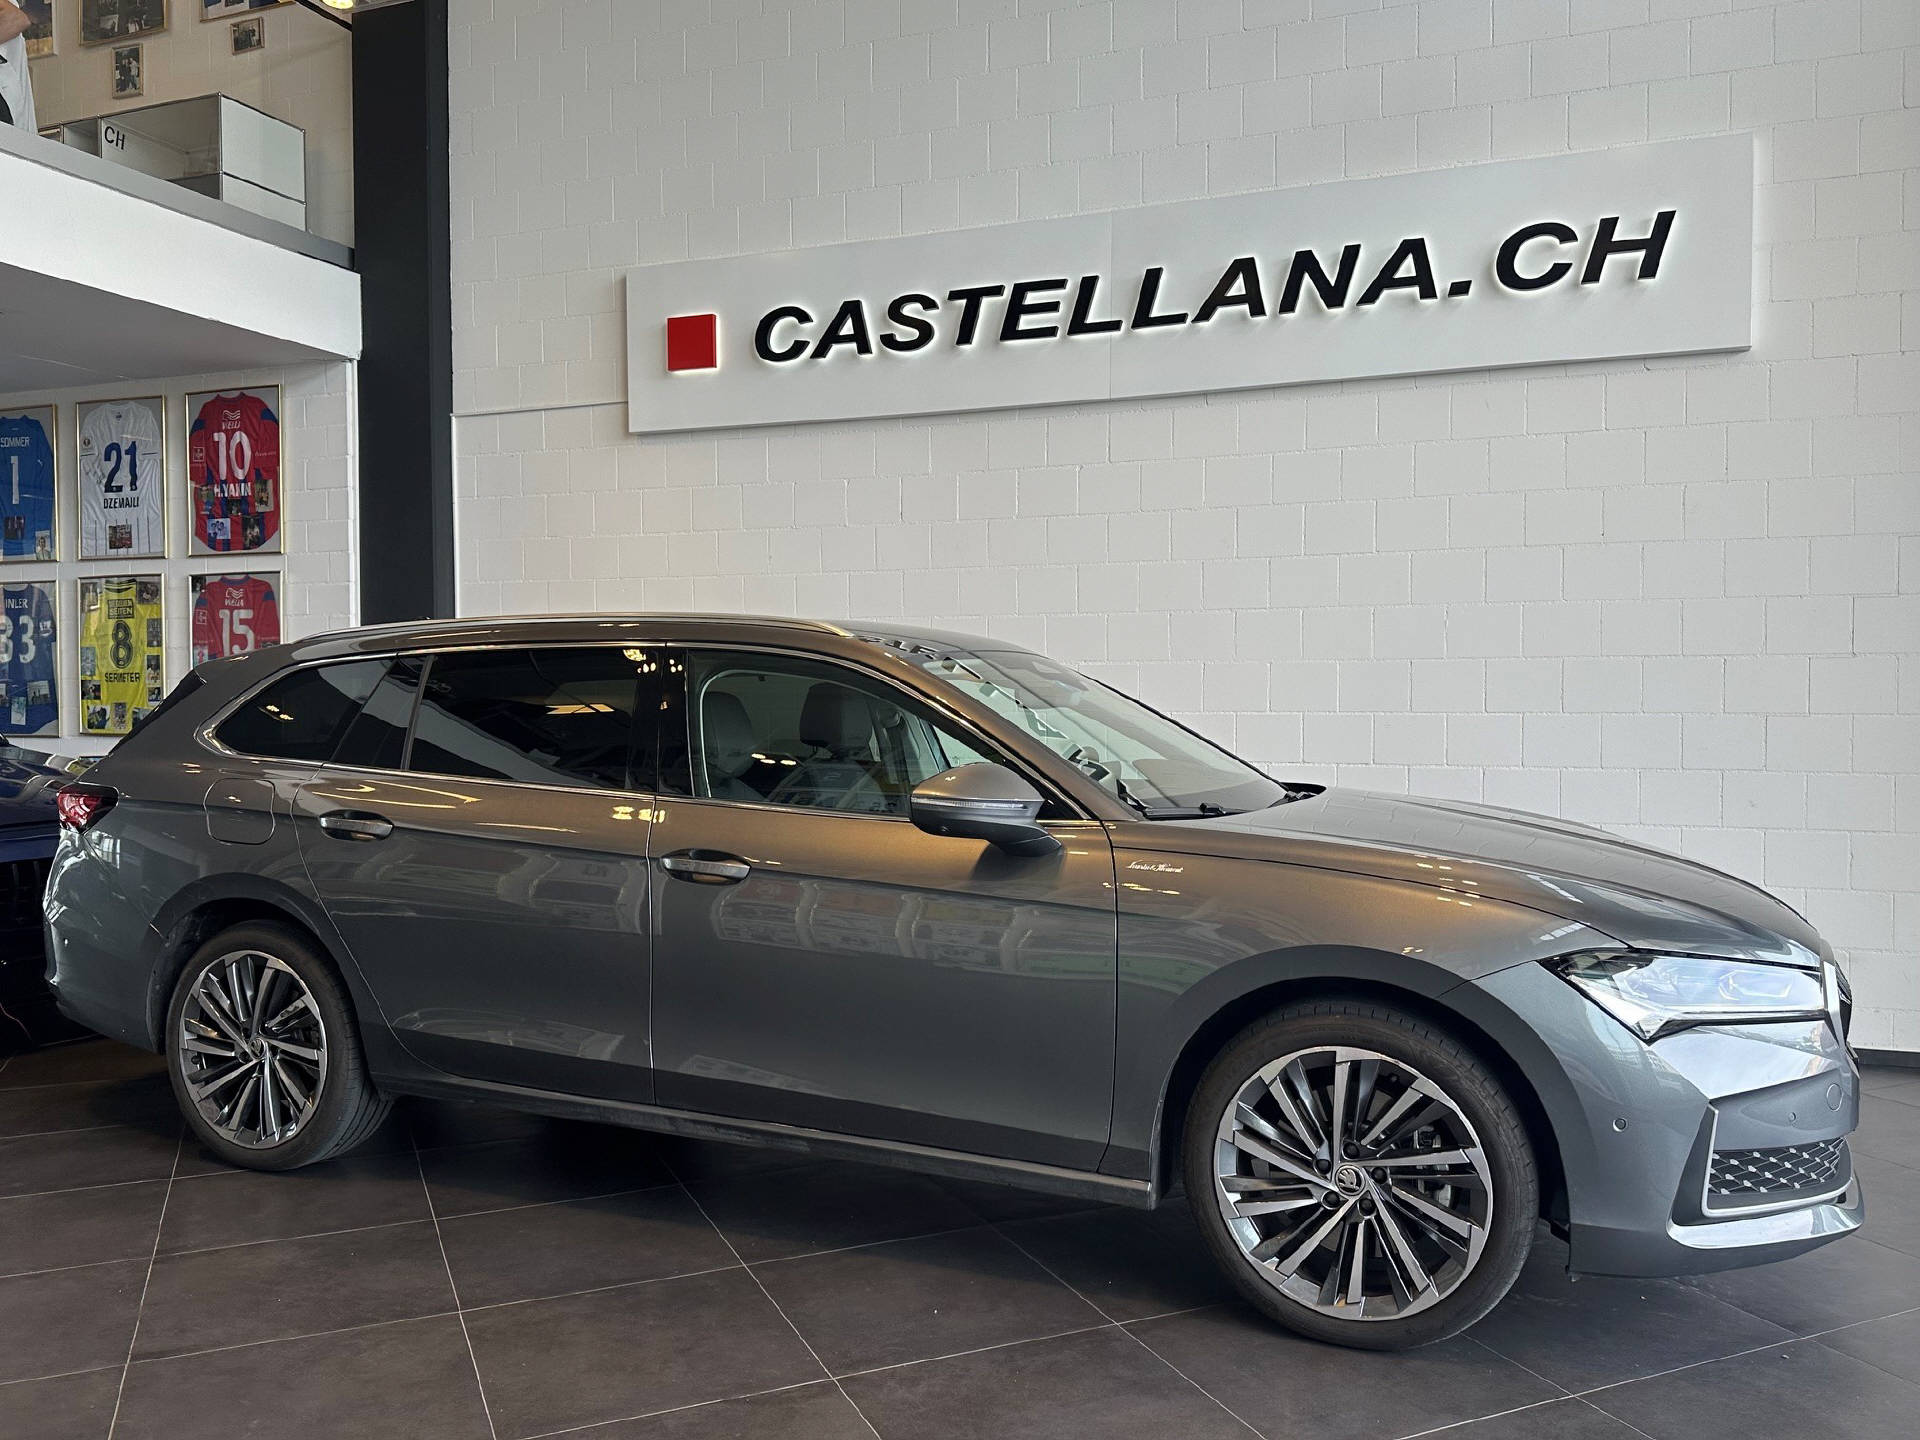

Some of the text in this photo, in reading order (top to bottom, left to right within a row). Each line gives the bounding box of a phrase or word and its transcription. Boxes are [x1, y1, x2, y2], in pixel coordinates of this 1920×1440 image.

[104, 126, 125, 150] CH
[754, 210, 1677, 363] CASTELLANA.CH
[11, 455, 20, 504] 1
[104, 441, 138, 493] 21
[213, 431, 252, 480] 10
[110, 620, 134, 669] 8
[219, 609, 255, 656] 15
